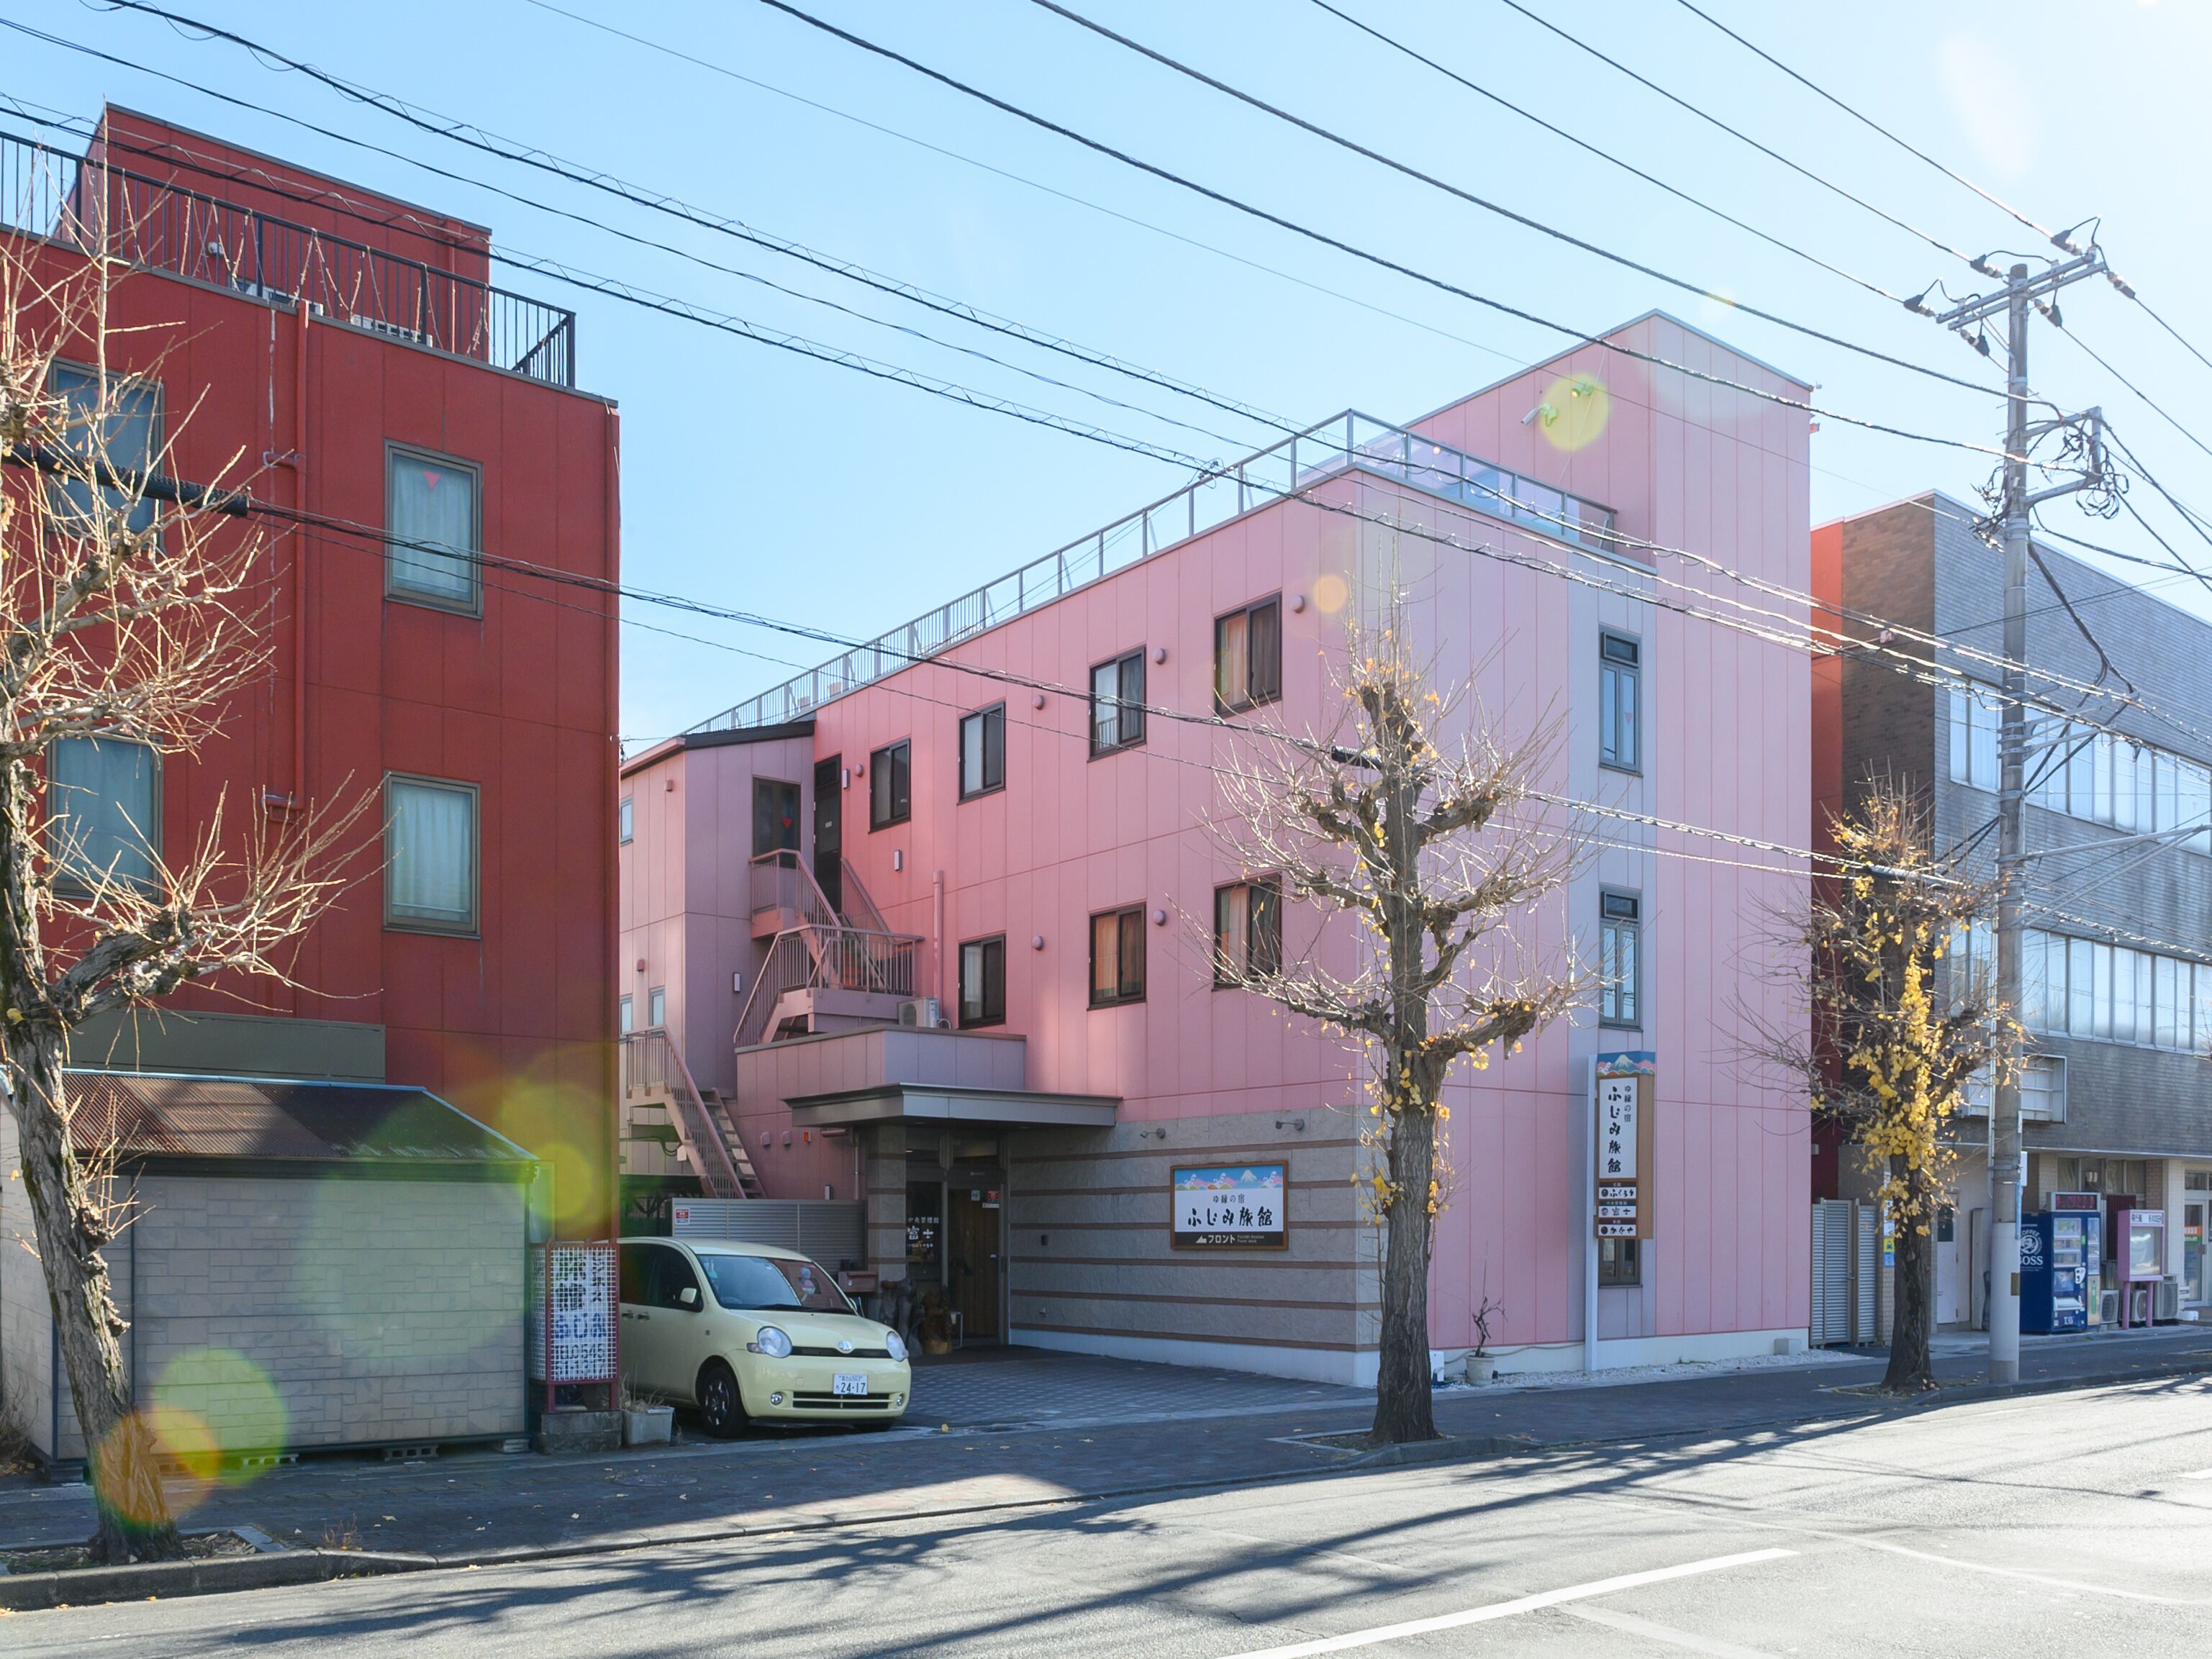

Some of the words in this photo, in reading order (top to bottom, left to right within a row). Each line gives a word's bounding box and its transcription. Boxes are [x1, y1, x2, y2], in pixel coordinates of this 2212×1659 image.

[1608, 1086, 1621, 1173] ふじみ旅館
[1212, 1193, 1246, 1204] ゆ縁の宿
[1610, 1188, 1634, 1198] ふくろう
[1187, 1206, 1273, 1227] ふじみ旅館
[907, 1225, 934, 1240] 富士
[1610, 1226, 1633, 1235] かぐや
[1207, 1234, 1236, 1244] フロント
